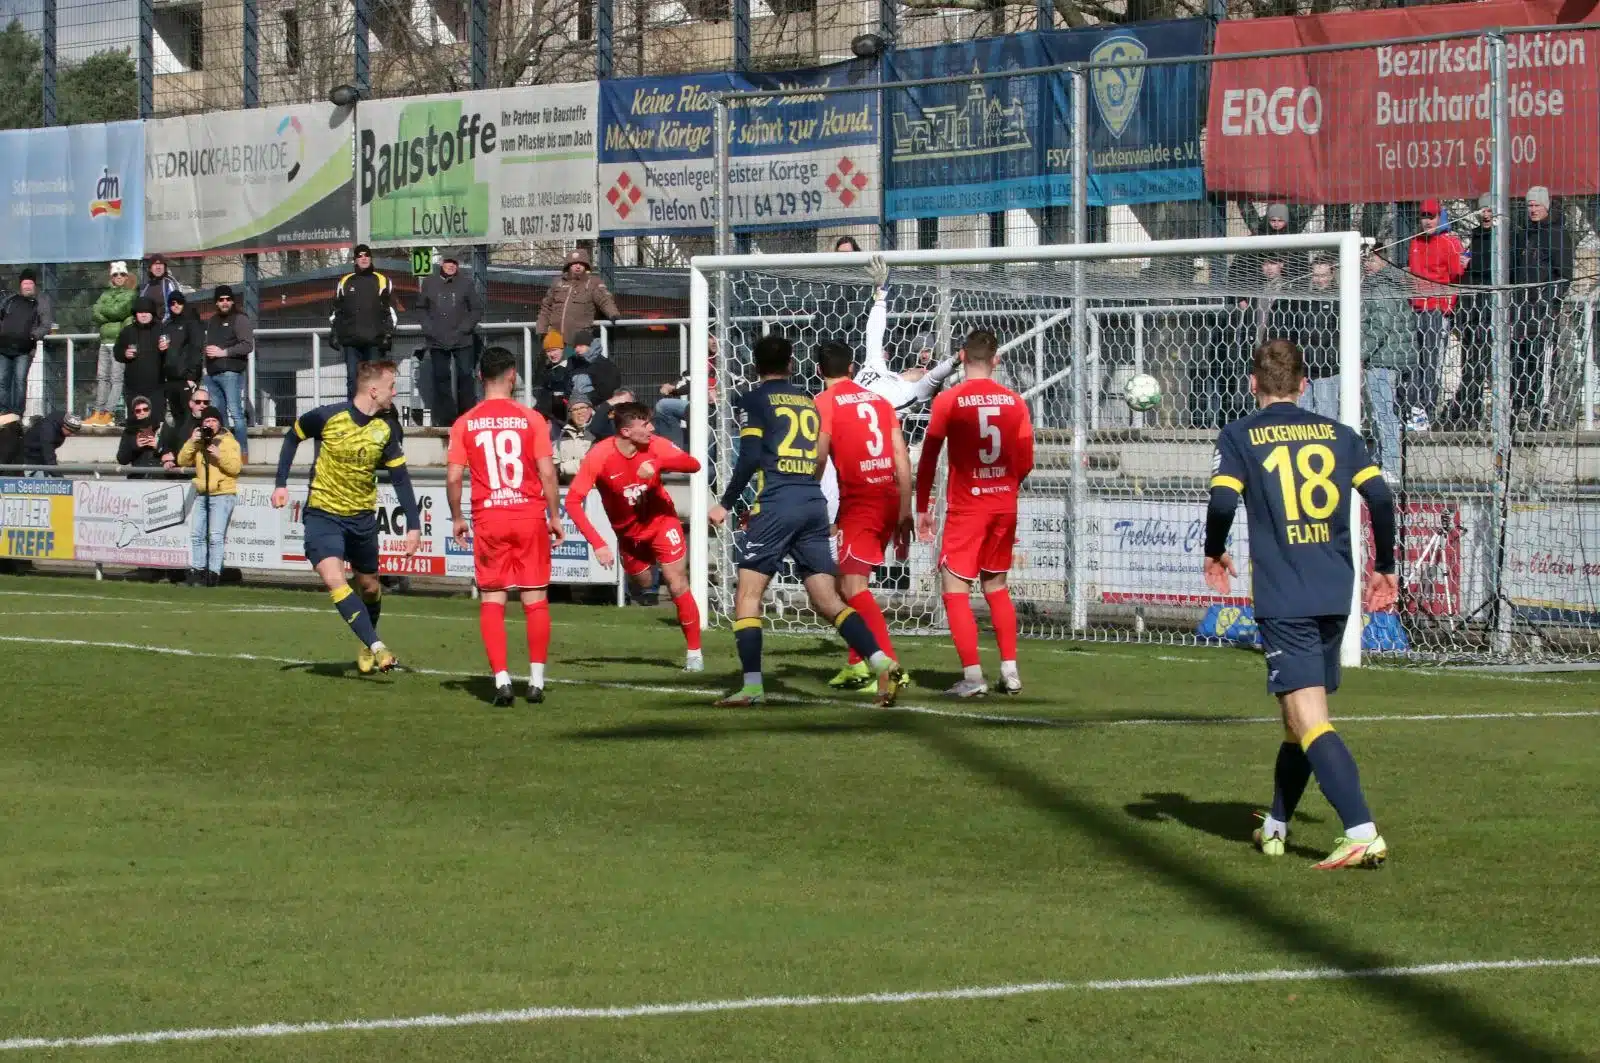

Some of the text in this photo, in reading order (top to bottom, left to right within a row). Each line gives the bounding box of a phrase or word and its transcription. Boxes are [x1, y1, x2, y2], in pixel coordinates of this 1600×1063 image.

[1376, 34, 1586, 78] Bezirksdiektion
[501, 104, 587, 127] Ihr Partner für Baustoffe
[631, 87, 675, 116] Keine
[1222, 86, 1323, 136] ERGO
[1376, 82, 1490, 125] Burkhard
[500, 129, 592, 152] vom Pflaster bis zum Dach
[604, 122, 655, 151] Meister
[657, 119, 712, 152] Körtge
[738, 115, 785, 148] sofort
[789, 118, 818, 144] zur
[819, 103, 873, 139] Hand.
[360, 113, 496, 207] Baustoffe
[1047, 141, 1198, 167] FSV Luckenwalde e.V.
[1376, 142, 1401, 170] Tel
[1408, 138, 1467, 168] 03371
[96, 167, 120, 200] dm
[645, 160, 818, 191] Fliesenlegereister Körtge
[412, 208, 469, 235] LouVet
[647, 197, 698, 222] Telefon
[754, 194, 773, 217] 64
[777, 192, 797, 216] 29
[801, 190, 823, 213] 99
[277, 226, 351, 242] www.diedruckfabrik.de
[501, 215, 518, 236] Tel.
[562, 213, 574, 233] 73
[577, 212, 593, 232] 40
[957, 394, 1015, 408] BABELSBERG
[467, 416, 528, 432] BABELSBERG
[775, 407, 820, 459] 29
[856, 402, 884, 457] 3
[977, 406, 1001, 465] 5
[1249, 424, 1337, 446] LUCKENWALDE
[474, 429, 524, 490] 18
[4, 481, 71, 494] am Seelenbinder
[1262, 443, 1340, 521] 18
[8, 530, 54, 556] TREFF
[665, 528, 681, 546] 19
[1113, 518, 1177, 549] Trebbin
[1286, 523, 1330, 545] FLATH
